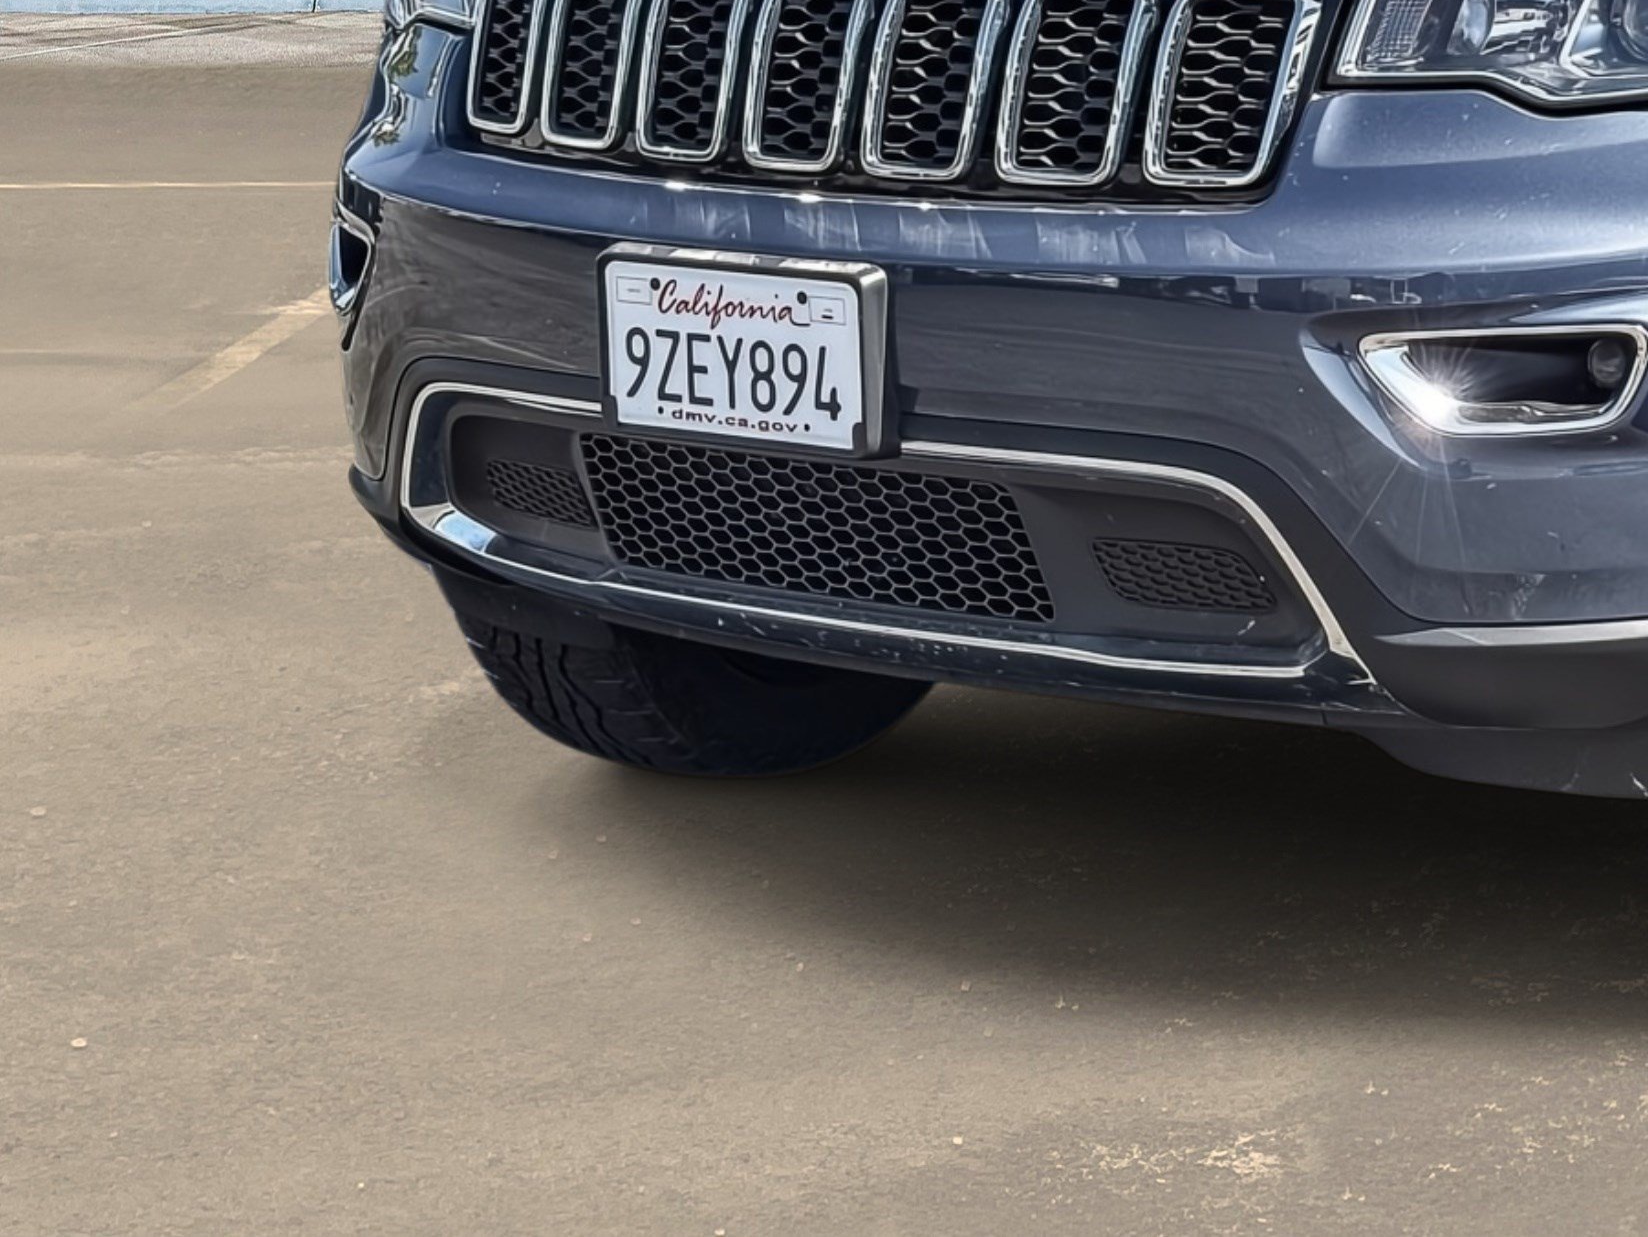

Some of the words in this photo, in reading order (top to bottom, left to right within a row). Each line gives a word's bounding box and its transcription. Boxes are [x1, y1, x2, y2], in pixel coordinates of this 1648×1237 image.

[657, 279, 811, 330] California
[625, 326, 843, 421] 9ZEY894
[671, 408, 799, 433] dmv.ca.gov
